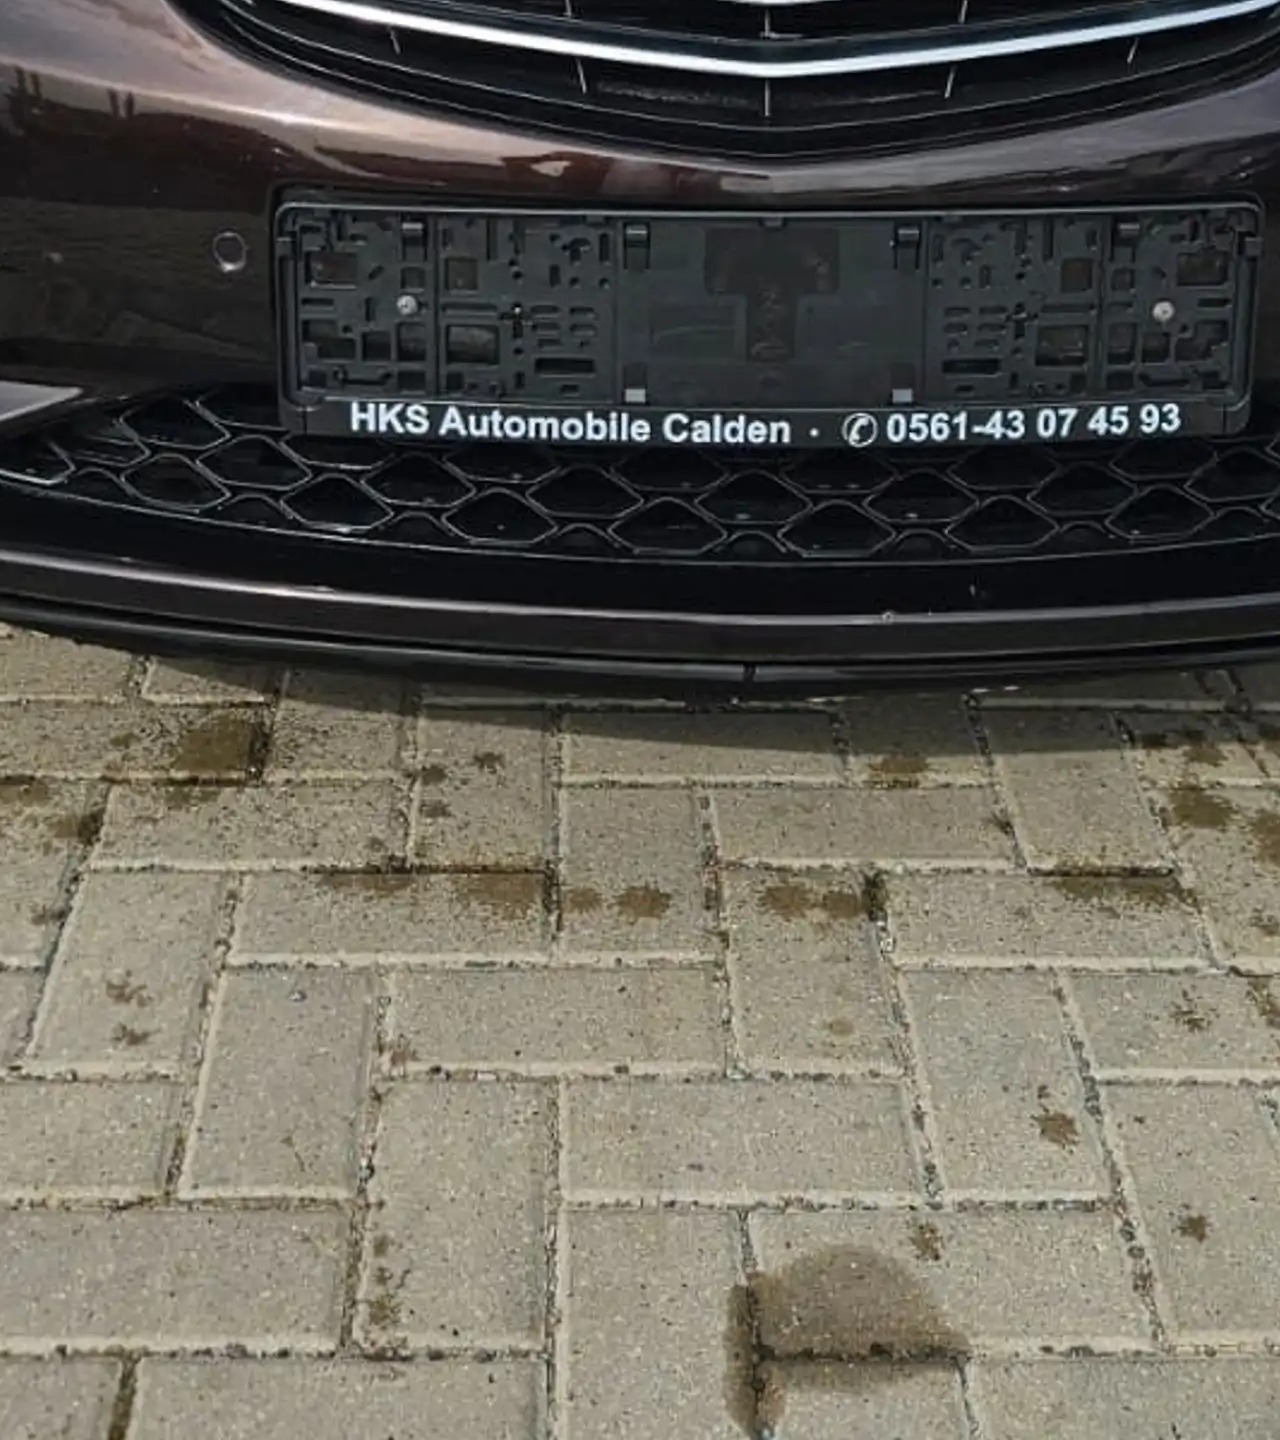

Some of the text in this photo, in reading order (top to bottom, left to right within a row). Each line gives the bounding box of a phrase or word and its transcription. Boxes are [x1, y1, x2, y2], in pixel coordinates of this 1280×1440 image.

[350, 400, 1181, 444] HKS Automobile Calden 0561-43 07 45 93
